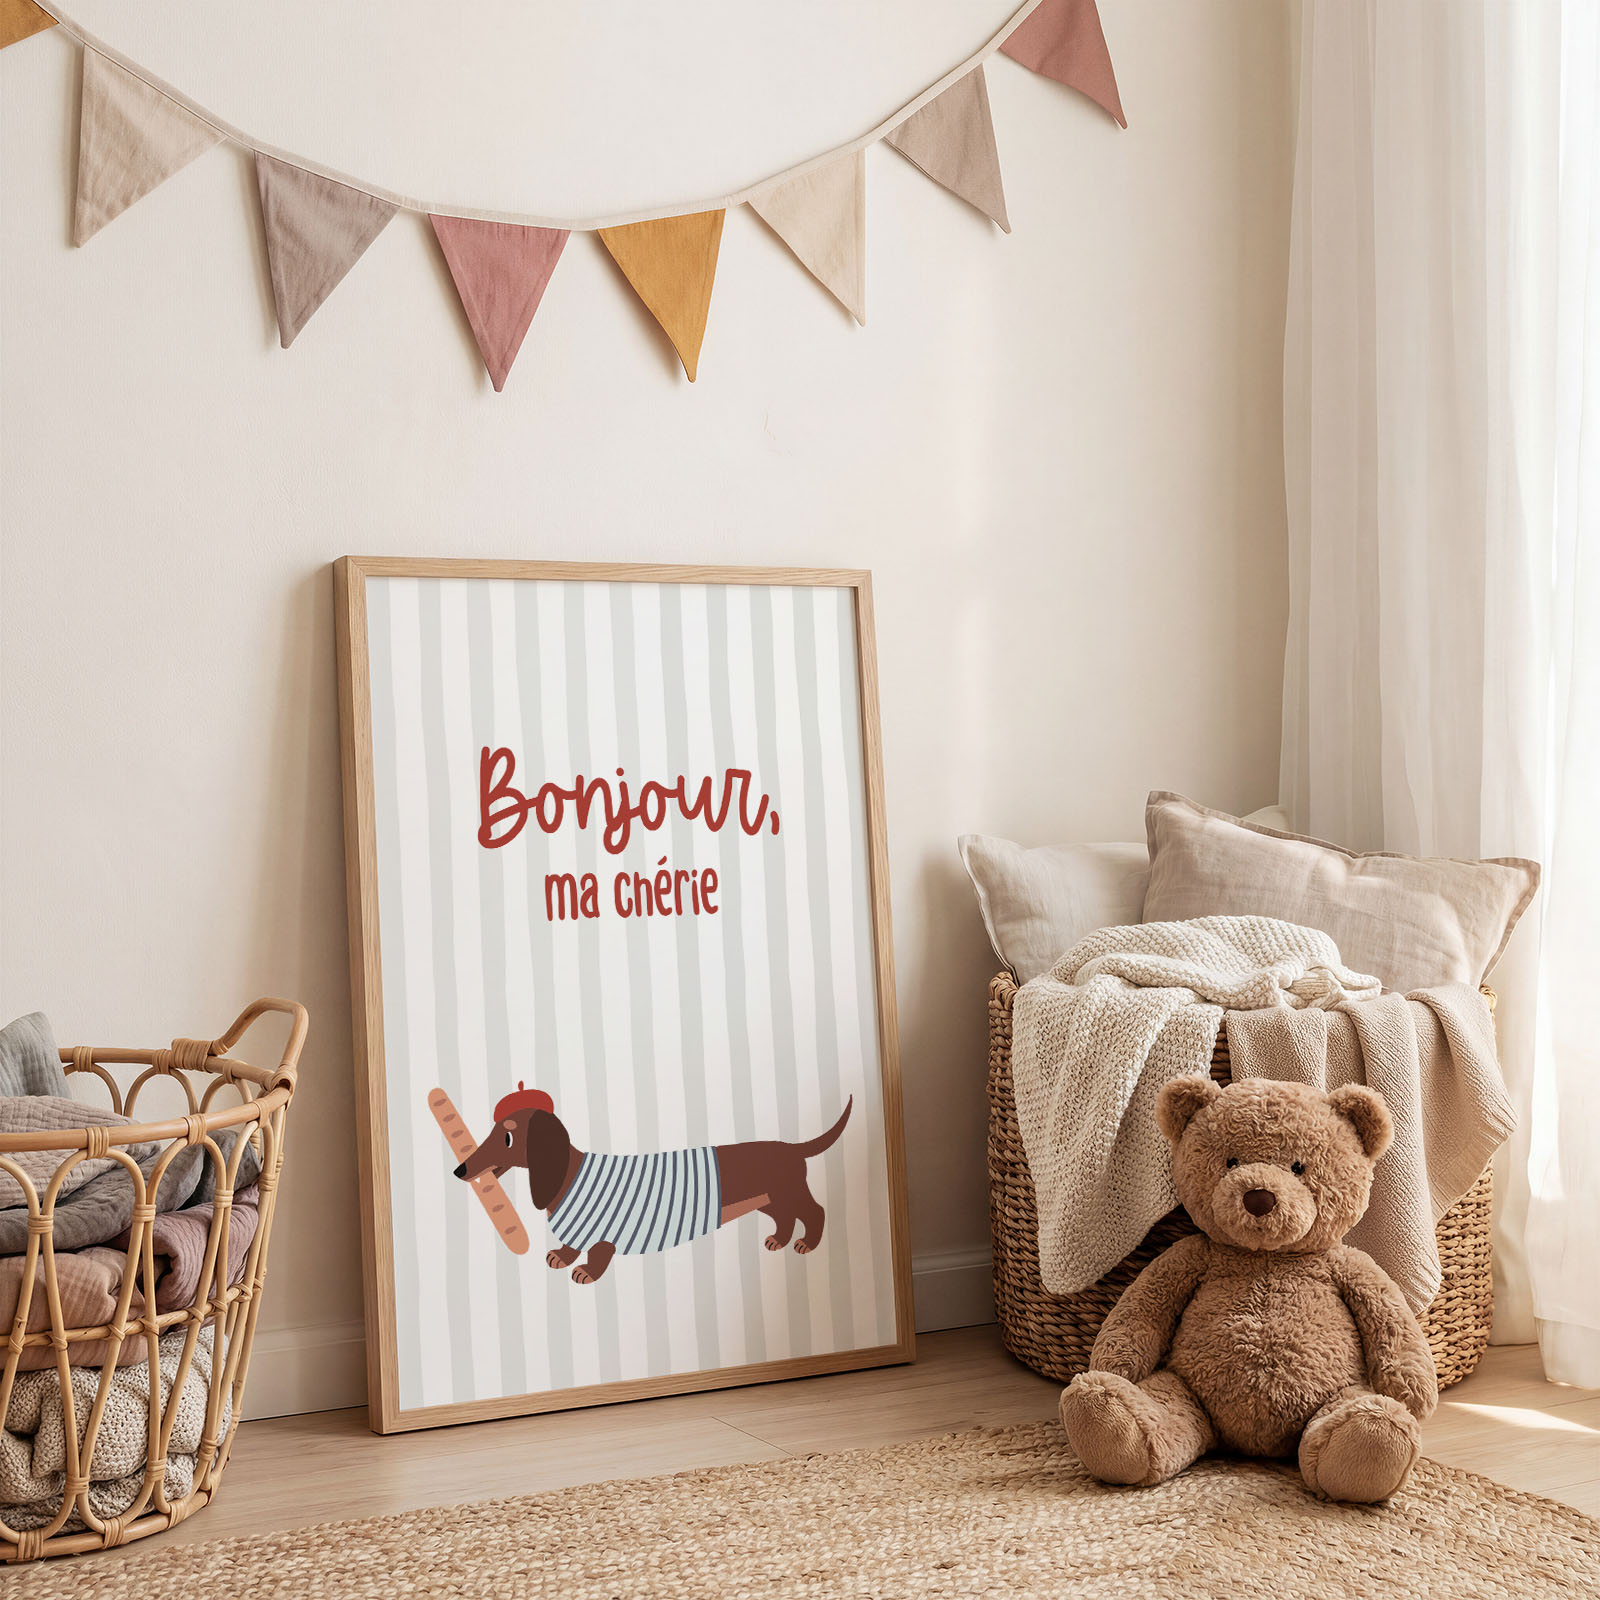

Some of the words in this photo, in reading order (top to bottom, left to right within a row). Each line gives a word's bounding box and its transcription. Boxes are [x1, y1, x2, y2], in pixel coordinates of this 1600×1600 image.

[478, 746, 780, 854] Bonjour,
[545, 872, 600, 921] ma
[614, 856, 718, 918] chérie
